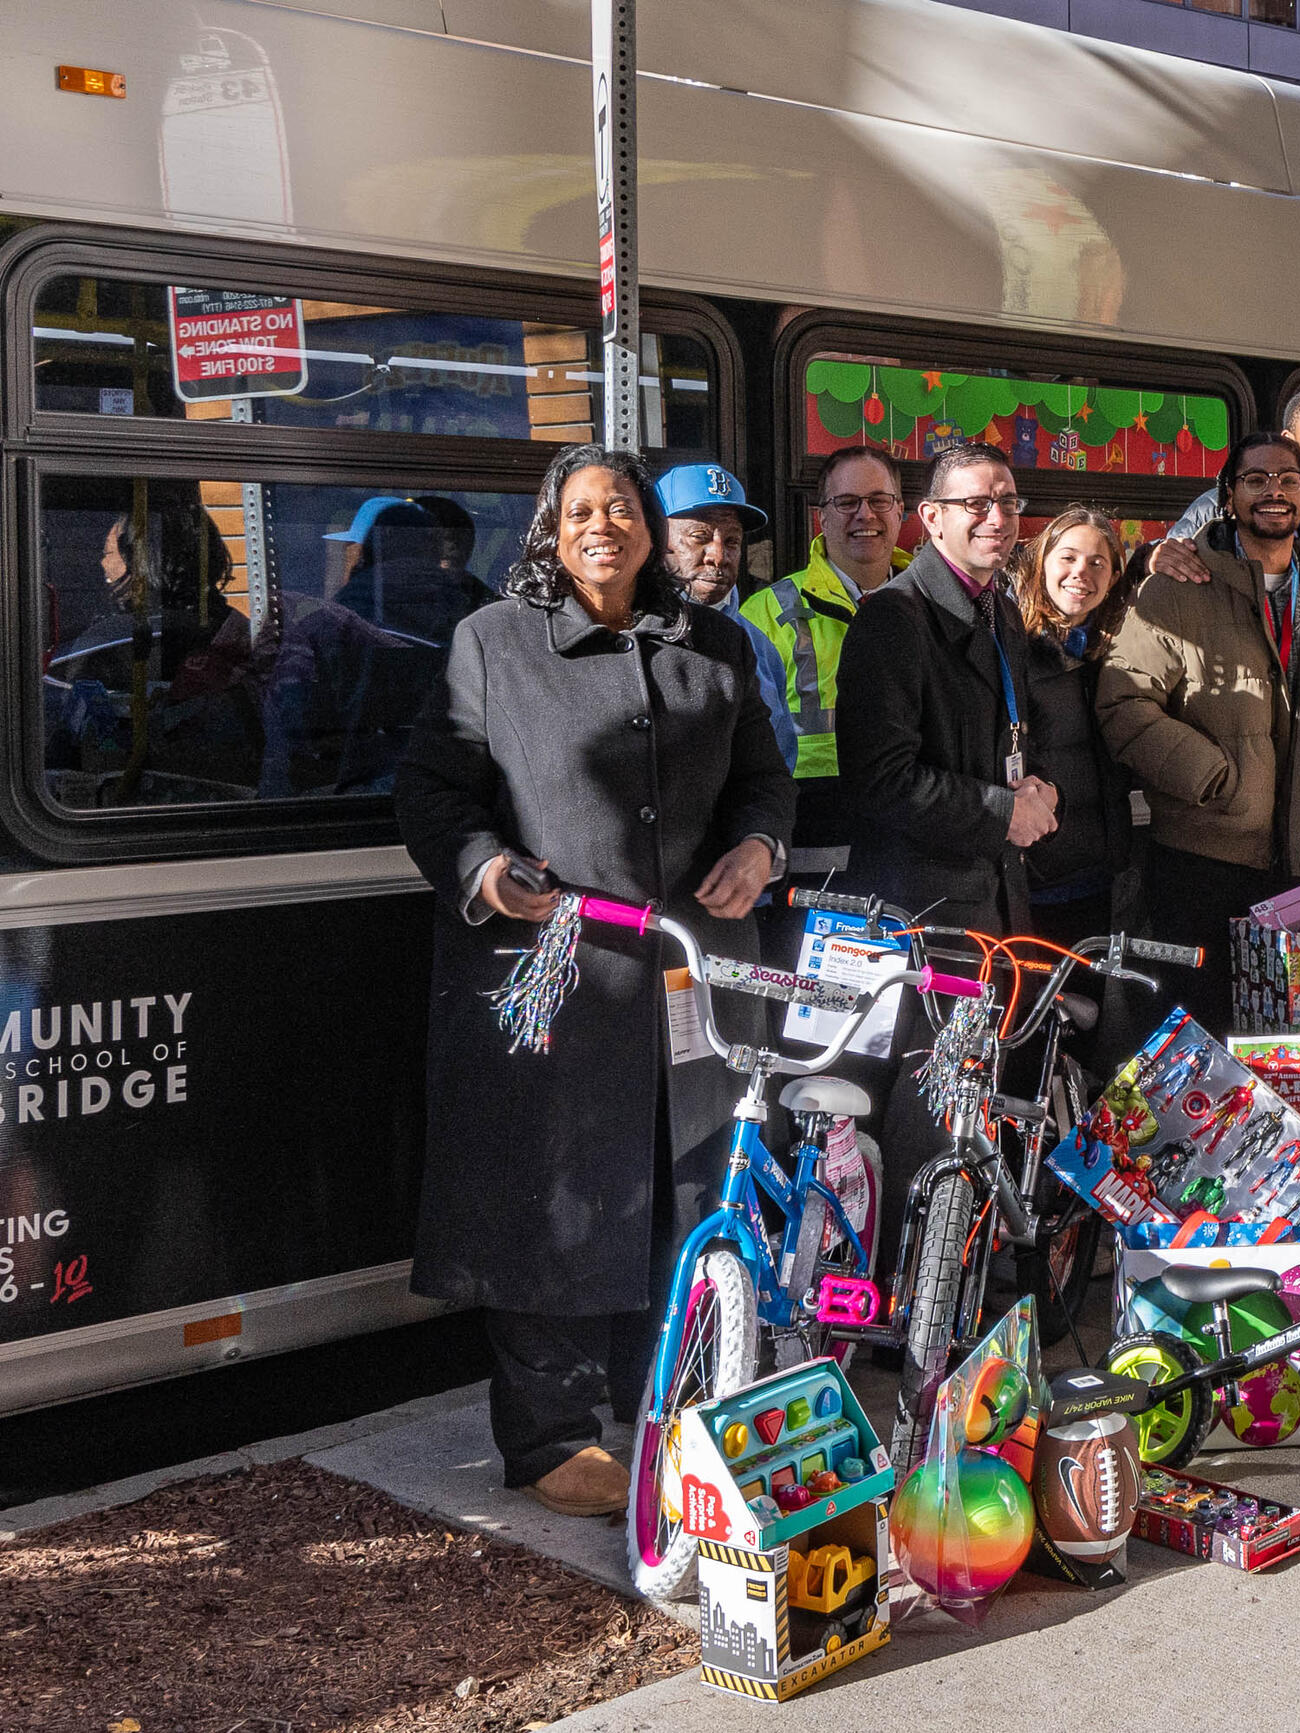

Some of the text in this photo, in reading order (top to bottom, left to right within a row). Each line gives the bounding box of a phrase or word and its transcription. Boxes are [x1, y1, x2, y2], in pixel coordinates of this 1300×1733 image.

[1254, 902, 1269, 916] 48
[5, 1040, 188, 1080] SCHOOL OF
[0, 1064, 188, 1125] RIDGE
[1063, 1393, 1135, 1416] NIKE VAPOR 24/7
[688, 1484, 697, 1531] Activities
[697, 1487, 707, 1531] Surprise
[706, 1495, 716, 1518] Pop
[780, 1640, 867, 1692] EXCAVATOR
